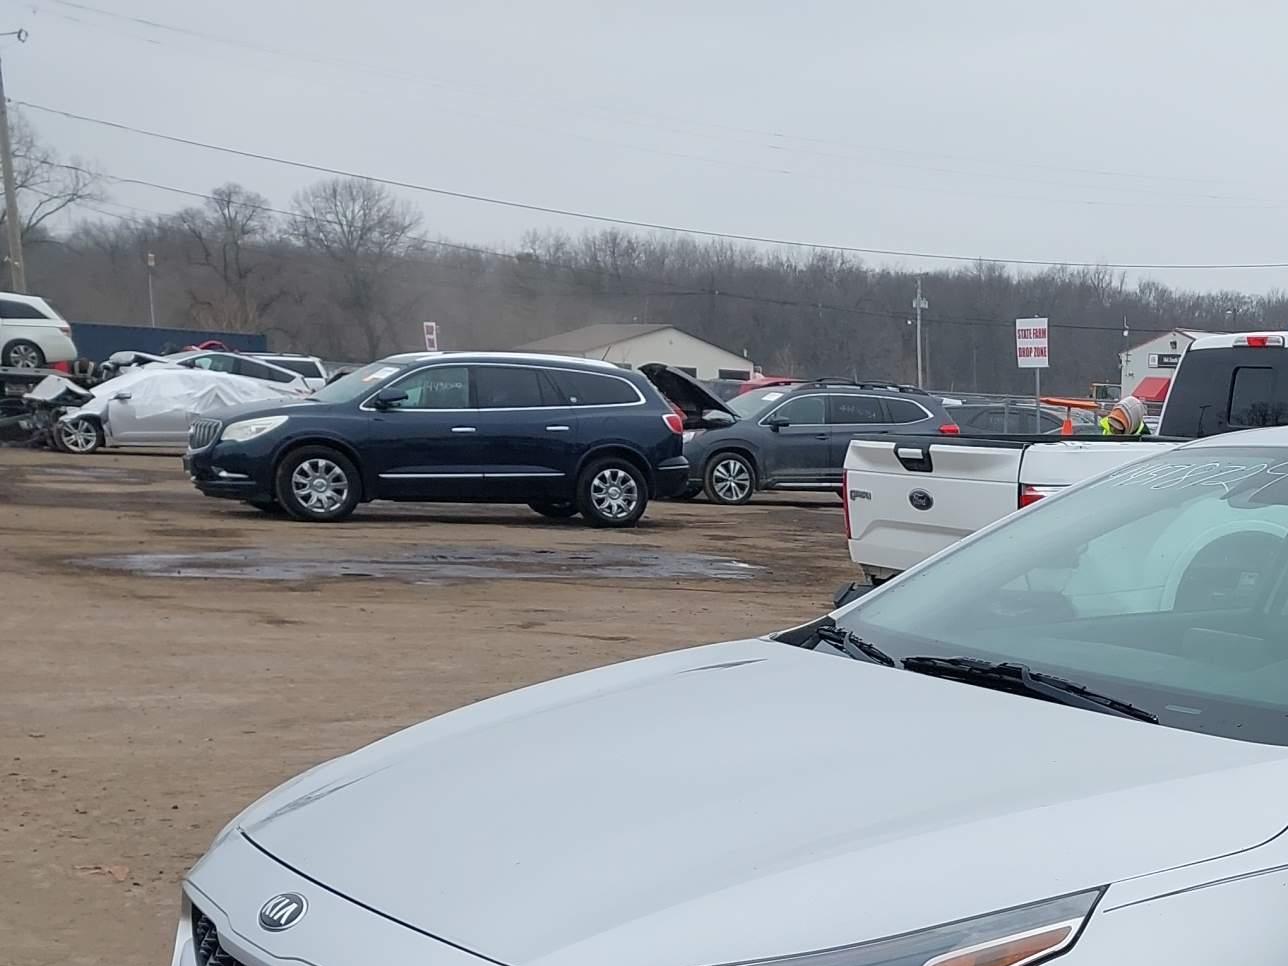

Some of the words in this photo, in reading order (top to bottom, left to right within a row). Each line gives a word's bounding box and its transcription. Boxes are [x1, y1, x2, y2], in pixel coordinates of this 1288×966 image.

[1017, 328, 1032, 339] STATE
[1033, 327, 1046, 338] FARM
[1018, 346, 1032, 357] DROP
[1034, 346, 1046, 357] ZONE
[262, 896, 298, 925] KIA
